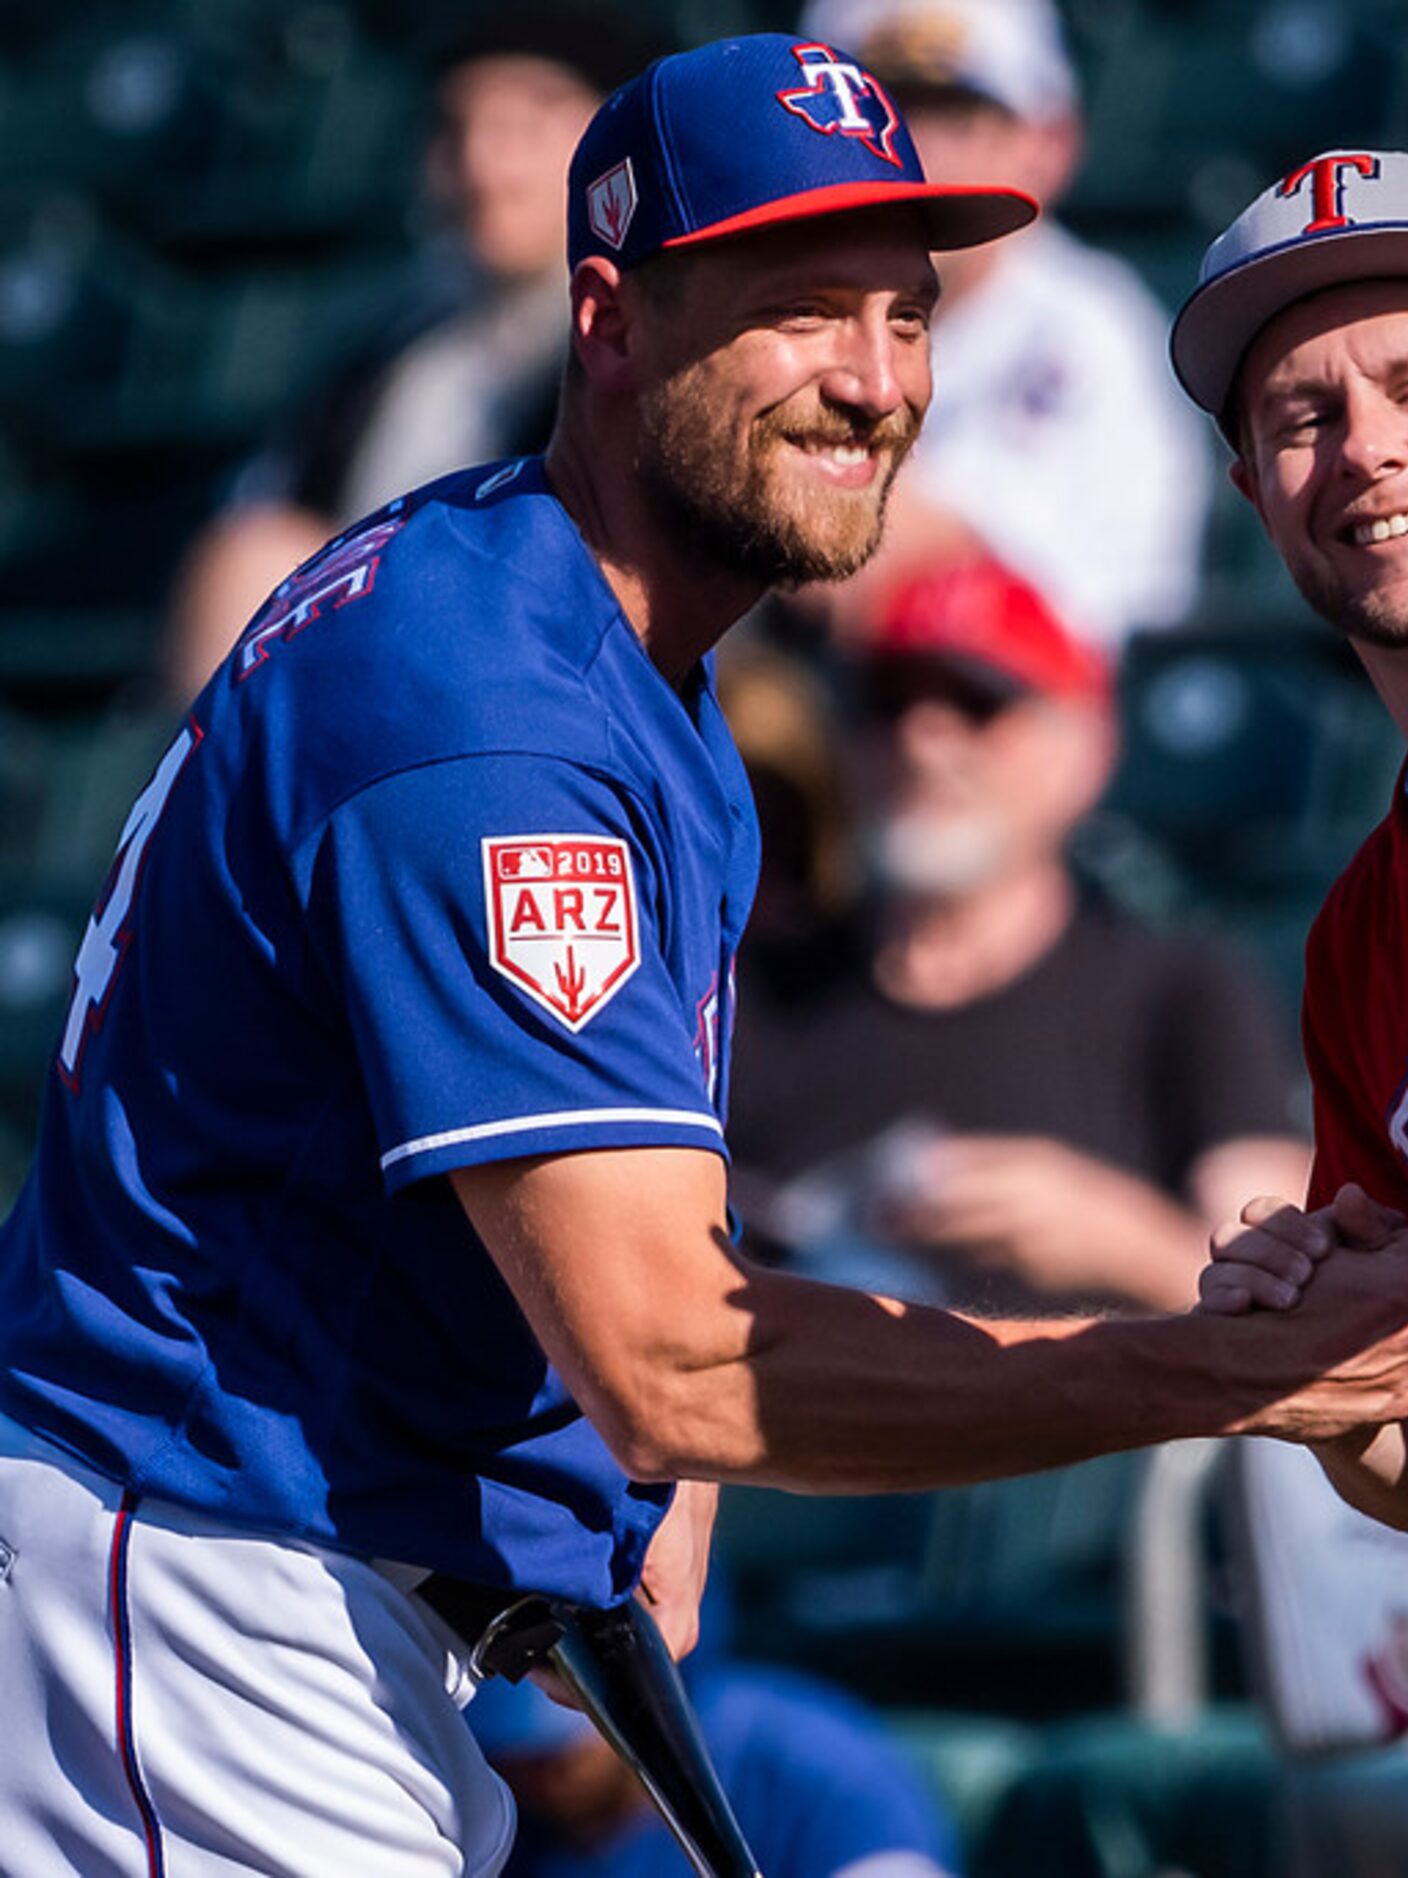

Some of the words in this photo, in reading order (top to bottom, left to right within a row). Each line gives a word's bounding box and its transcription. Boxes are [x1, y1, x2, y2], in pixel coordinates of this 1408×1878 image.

[801, 63, 871, 133] T
[1275, 154, 1380, 234] T
[557, 851, 622, 876] 2019
[510, 887, 621, 933] ARZ
